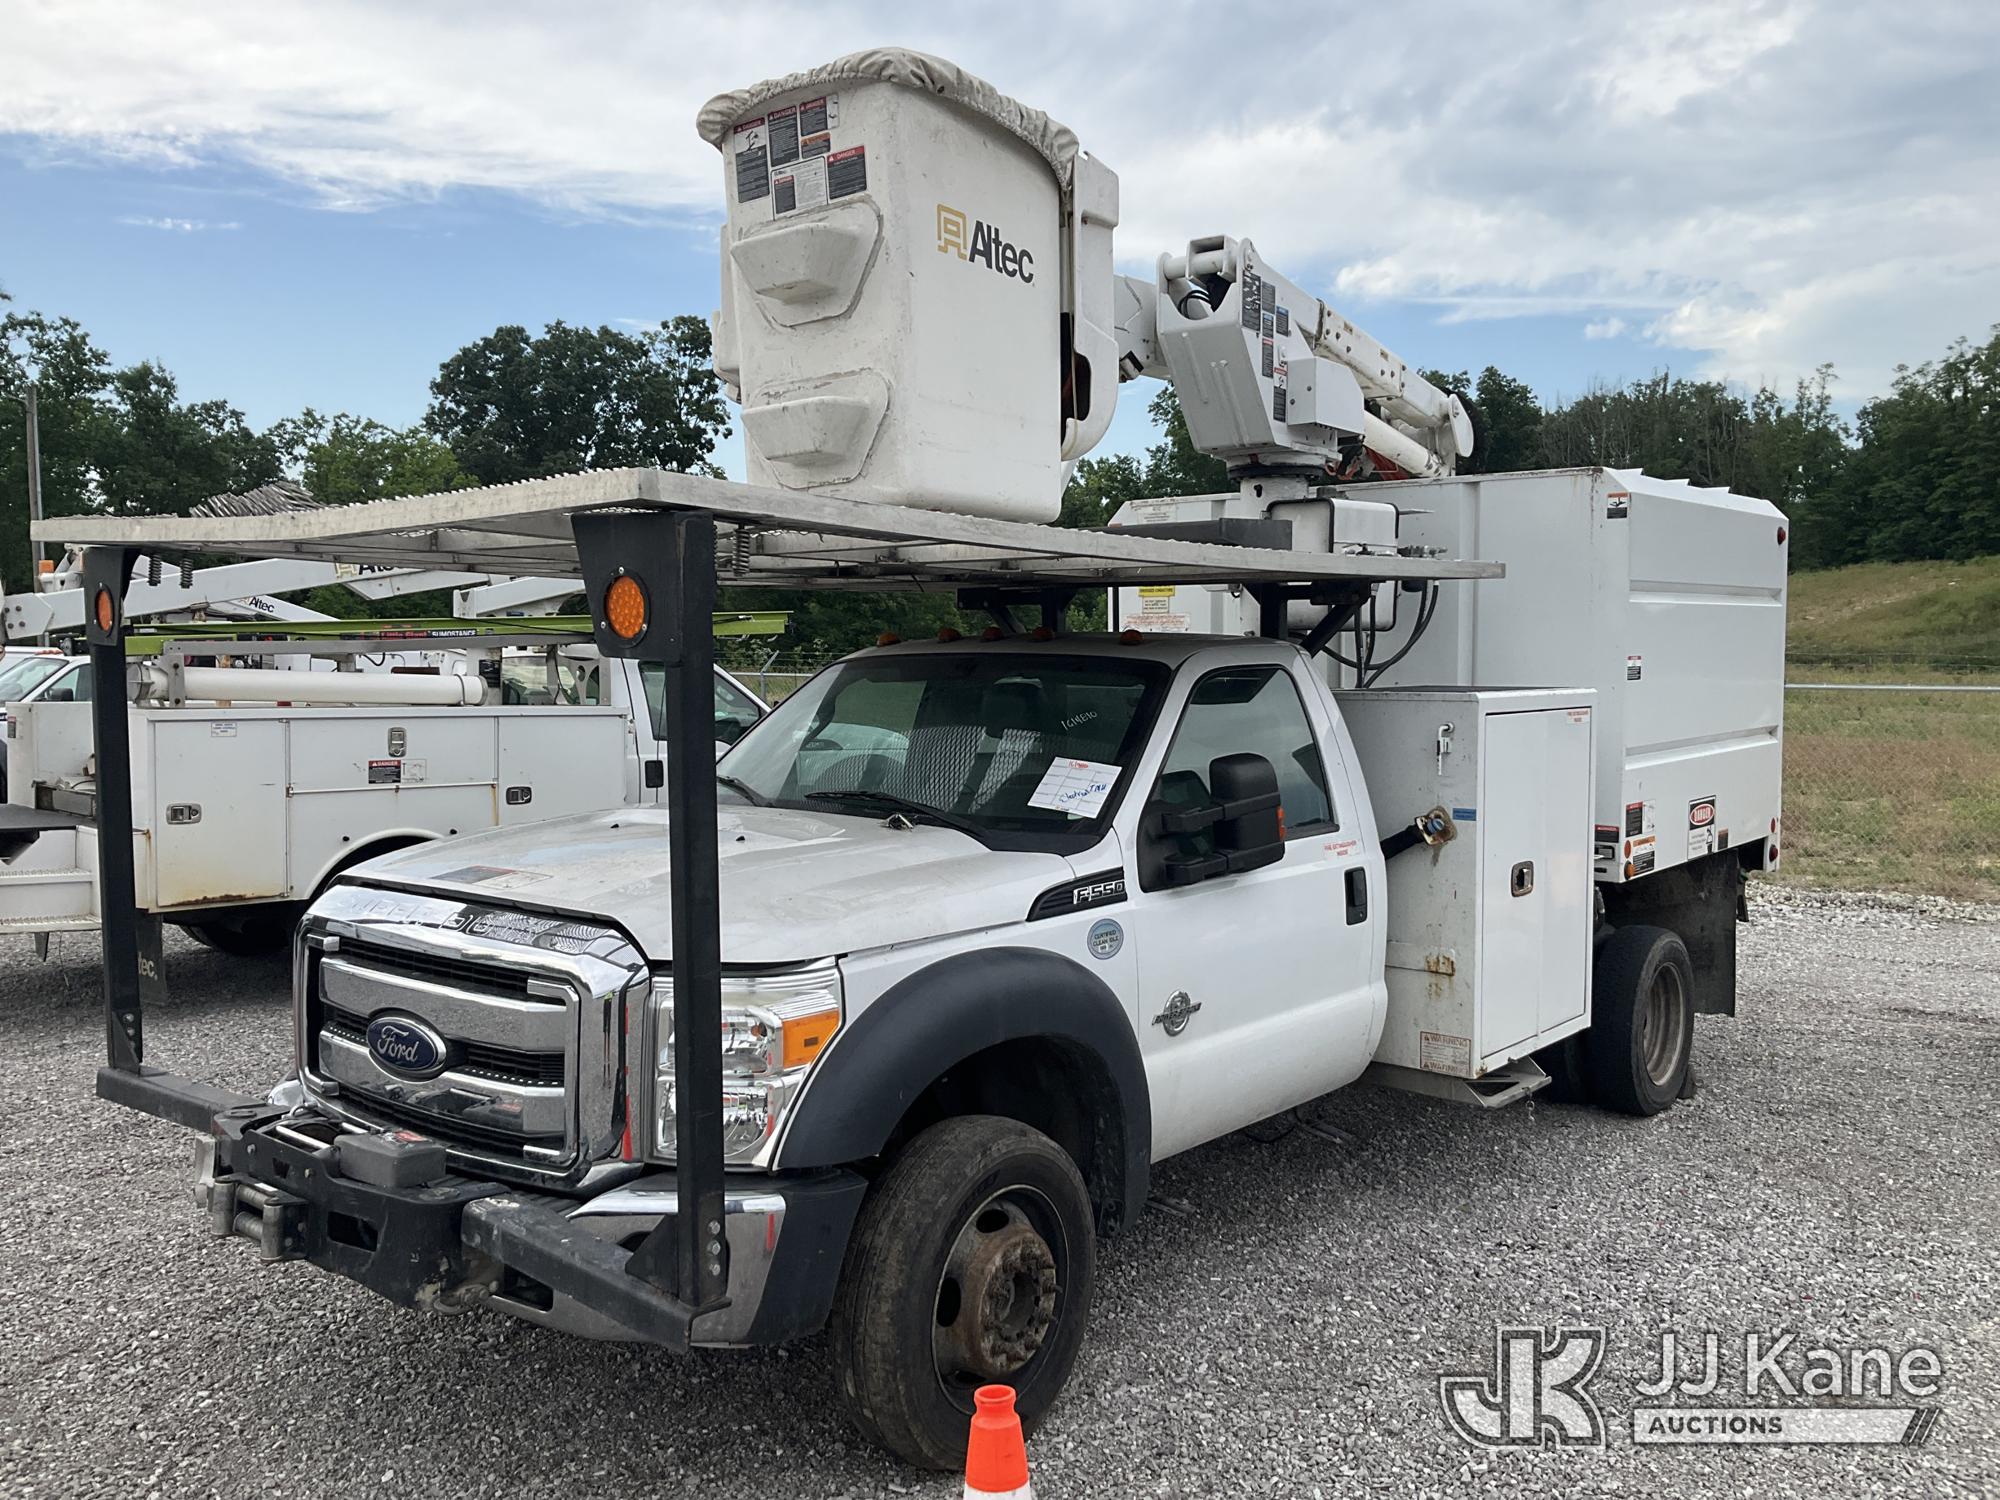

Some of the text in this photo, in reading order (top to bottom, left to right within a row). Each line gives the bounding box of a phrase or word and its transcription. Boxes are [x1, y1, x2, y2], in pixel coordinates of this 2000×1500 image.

[969, 220, 1034, 284] Altec
[248, 596, 276, 614] Altec
[377, 1025, 420, 1063] Ford
